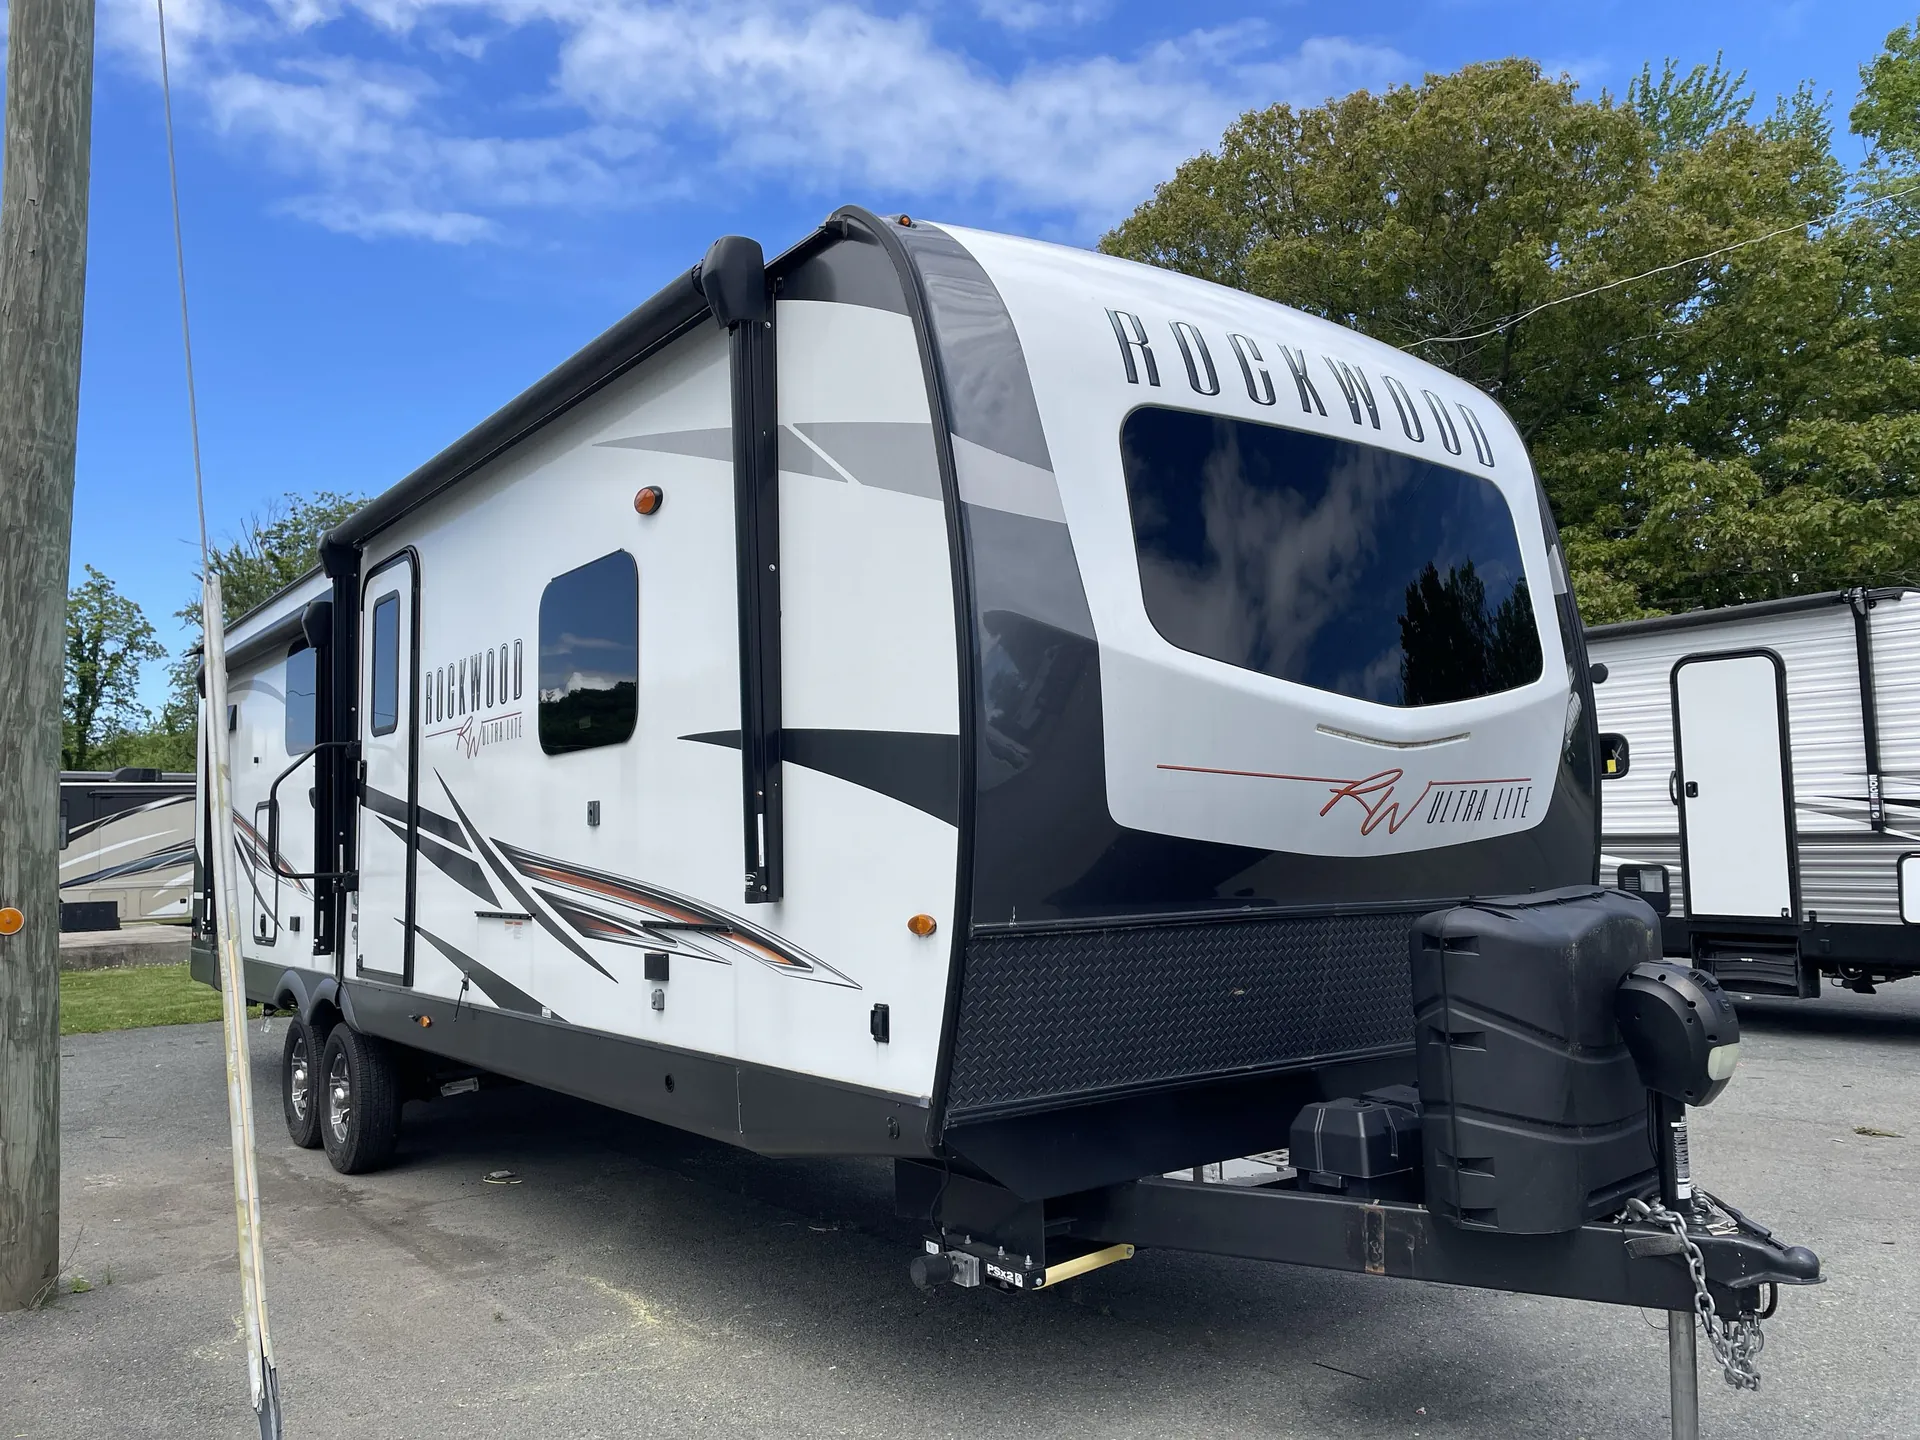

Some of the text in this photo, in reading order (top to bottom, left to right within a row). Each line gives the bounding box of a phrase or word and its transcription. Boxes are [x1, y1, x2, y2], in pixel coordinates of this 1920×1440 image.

[1104, 307, 1495, 467] ROCKWOOD
[425, 638, 522, 725] ROCKWOOD
[456, 716, 522, 759] RW ULTRA LITE
[1320, 768, 1532, 836] RW ULTRA LITE
